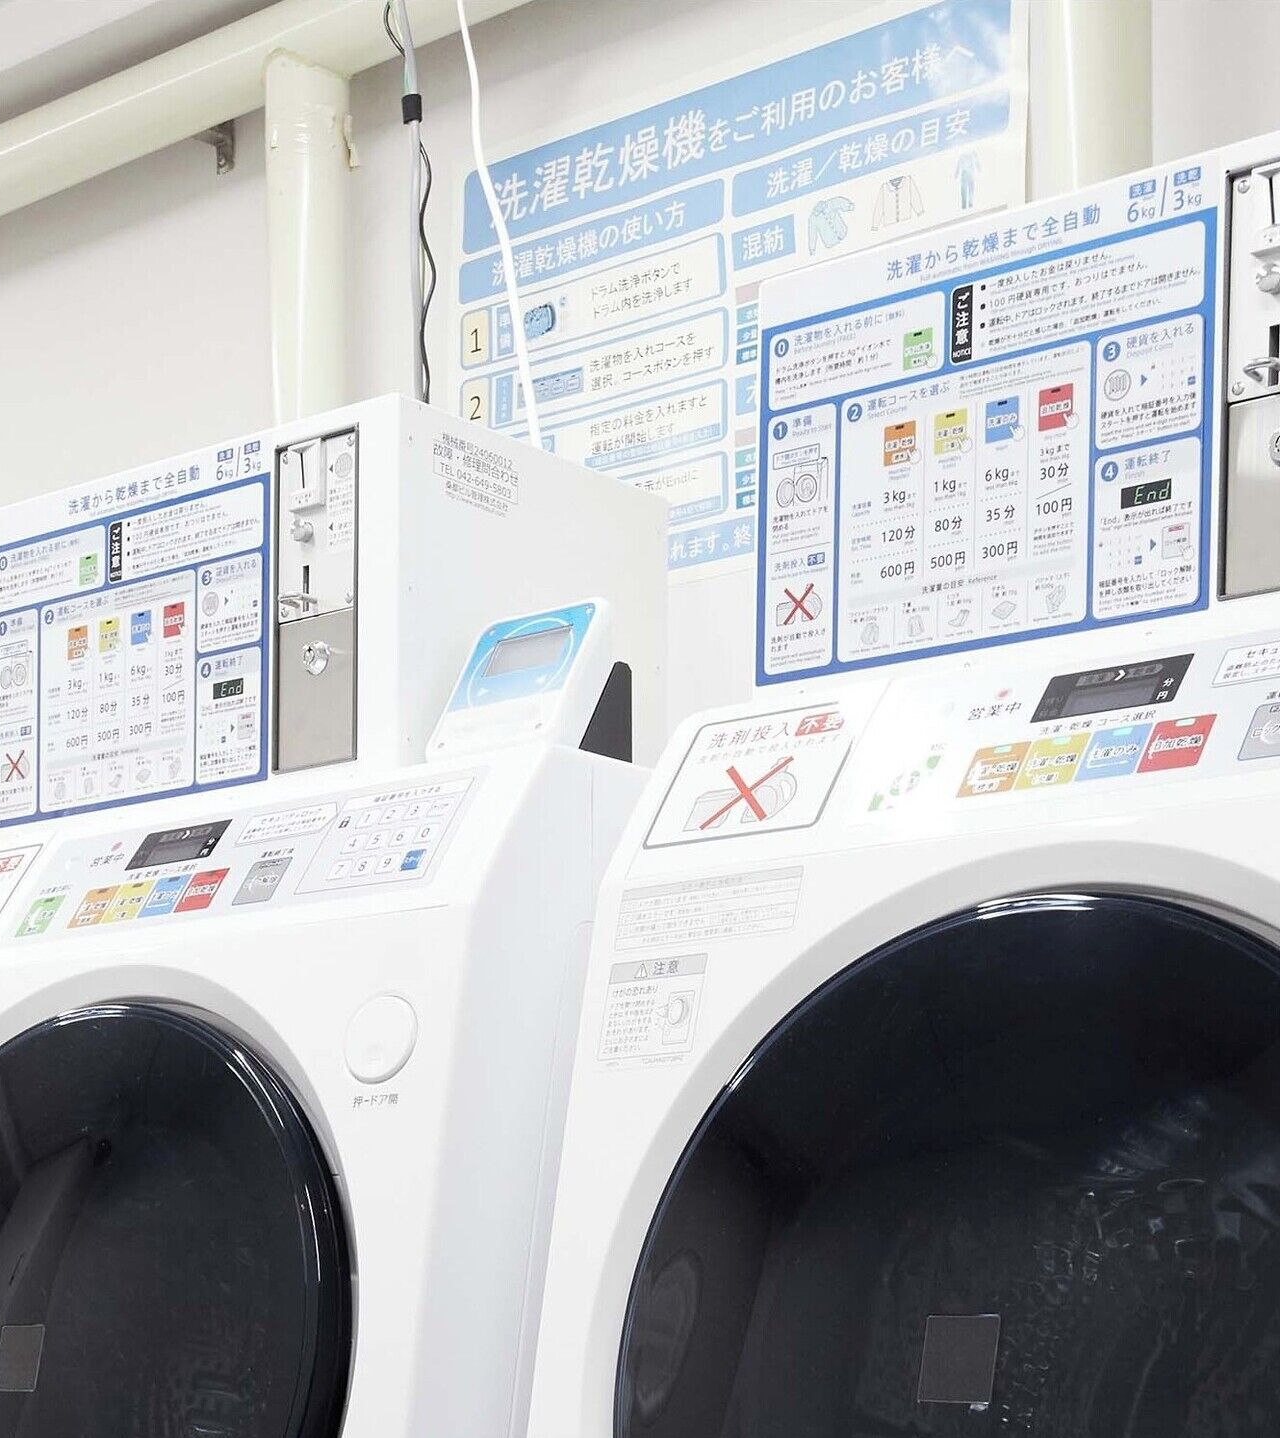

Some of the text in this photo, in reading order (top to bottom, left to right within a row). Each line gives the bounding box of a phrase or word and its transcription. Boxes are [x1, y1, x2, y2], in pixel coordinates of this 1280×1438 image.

[491, 43, 974, 229] 洗濯乾燥機をご利用のお客様へ
[742, 226, 784, 260] 混紡
[887, 204, 1101, 280] 洗濯から乾燥まで全自動
[794, 313, 884, 347] 洗濯物を入れる前に
[955, 293, 970, 346] ご注意
[470, 328, 482, 353] 1
[1126, 323, 1195, 349] 硬貨を入れる
[470, 395, 482, 421] 2
[867, 380, 950, 412] 運転コースを選ぶ
[1040, 463, 1069, 481] 30分
[1124, 449, 1171, 471] 運転終了
[68, 464, 200, 516] 洗濯から乾燥まで全自動
[1133, 482, 1171, 506] End
[1036, 497, 1072, 516] 100円
[881, 525, 915, 544] 120分
[934, 516, 963, 533] 80分
[930, 551, 966, 570] 500円
[982, 541, 1018, 560] 300円
[880, 561, 915, 580] 600円
[220, 680, 243, 698] End
[968, 701, 1022, 721] 営業中
[708, 722, 790, 749] 洗剤投入
[652, 959, 680, 976] 注意
